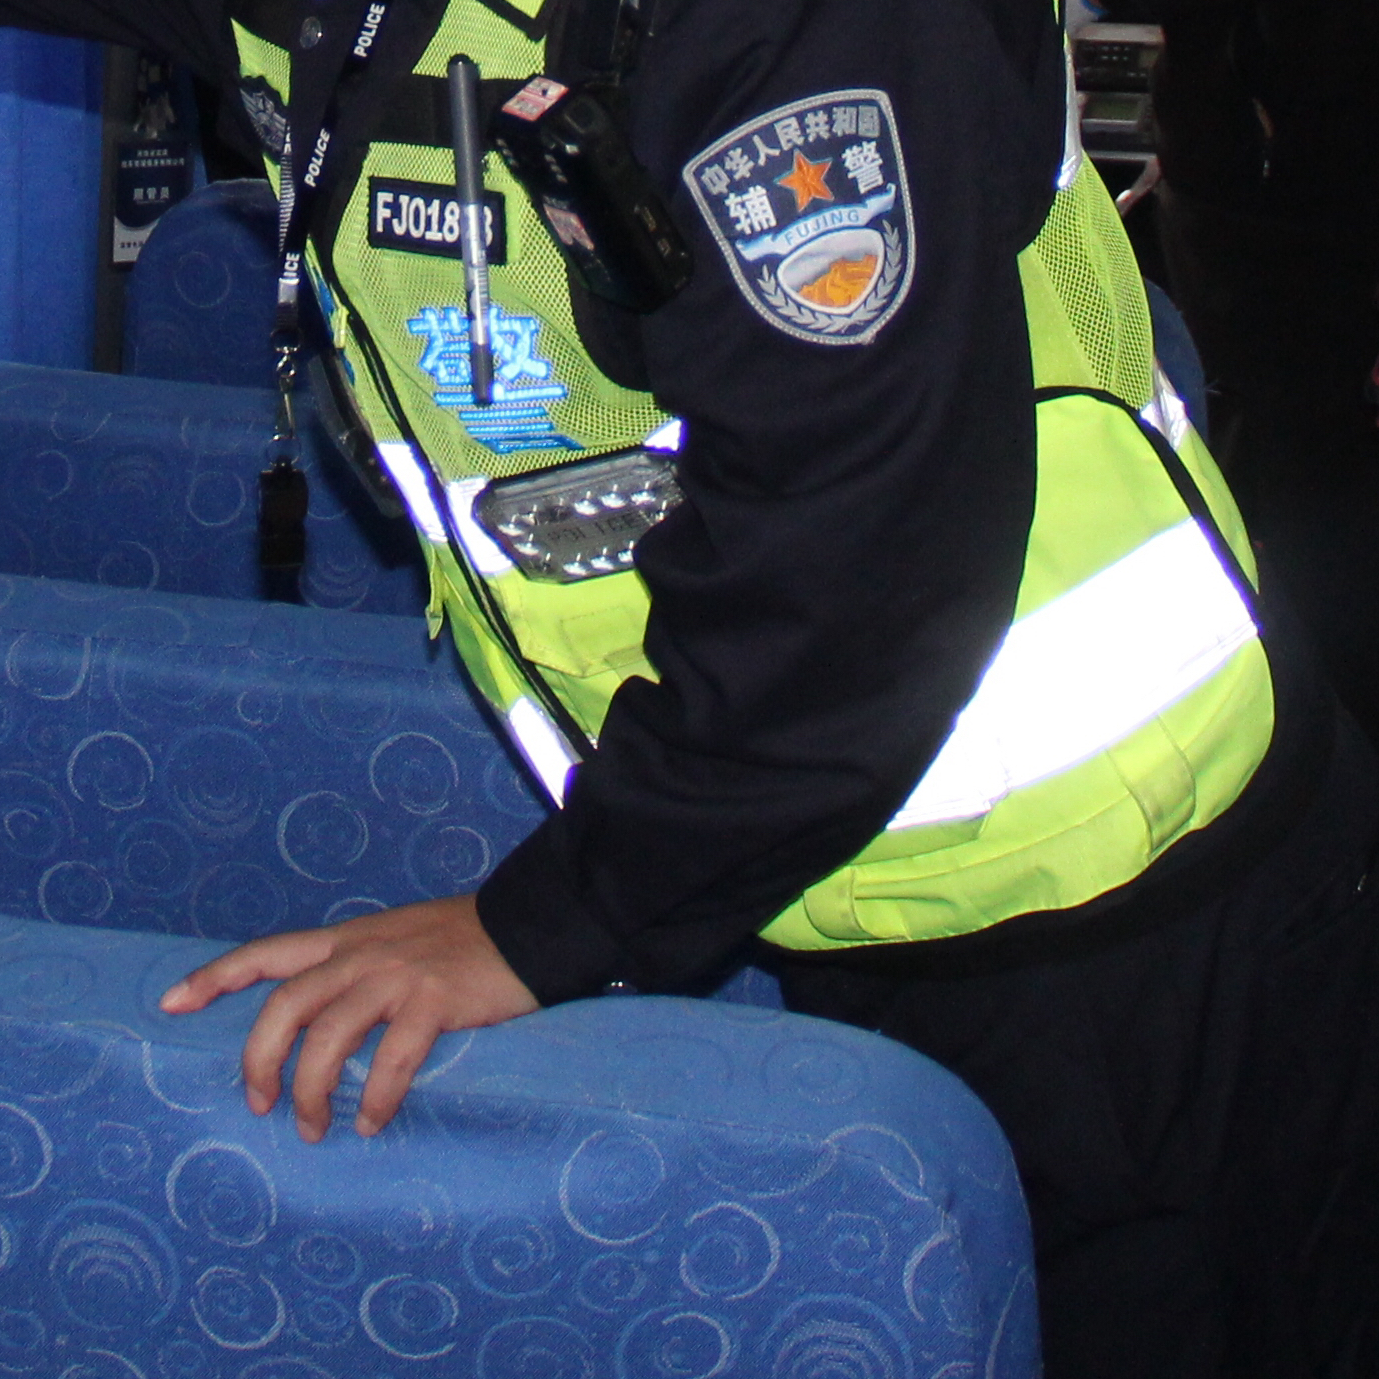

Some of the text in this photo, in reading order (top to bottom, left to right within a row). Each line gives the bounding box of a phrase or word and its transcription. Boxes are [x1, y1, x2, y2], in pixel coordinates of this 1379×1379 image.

[353, 3, 385, 58] POLICE
[304, 127, 331, 188] POLICE
[700, 105, 881, 196] 中华人民共和国
[376, 191, 494, 248] FJ018
[784, 208, 860, 246] FUJING
